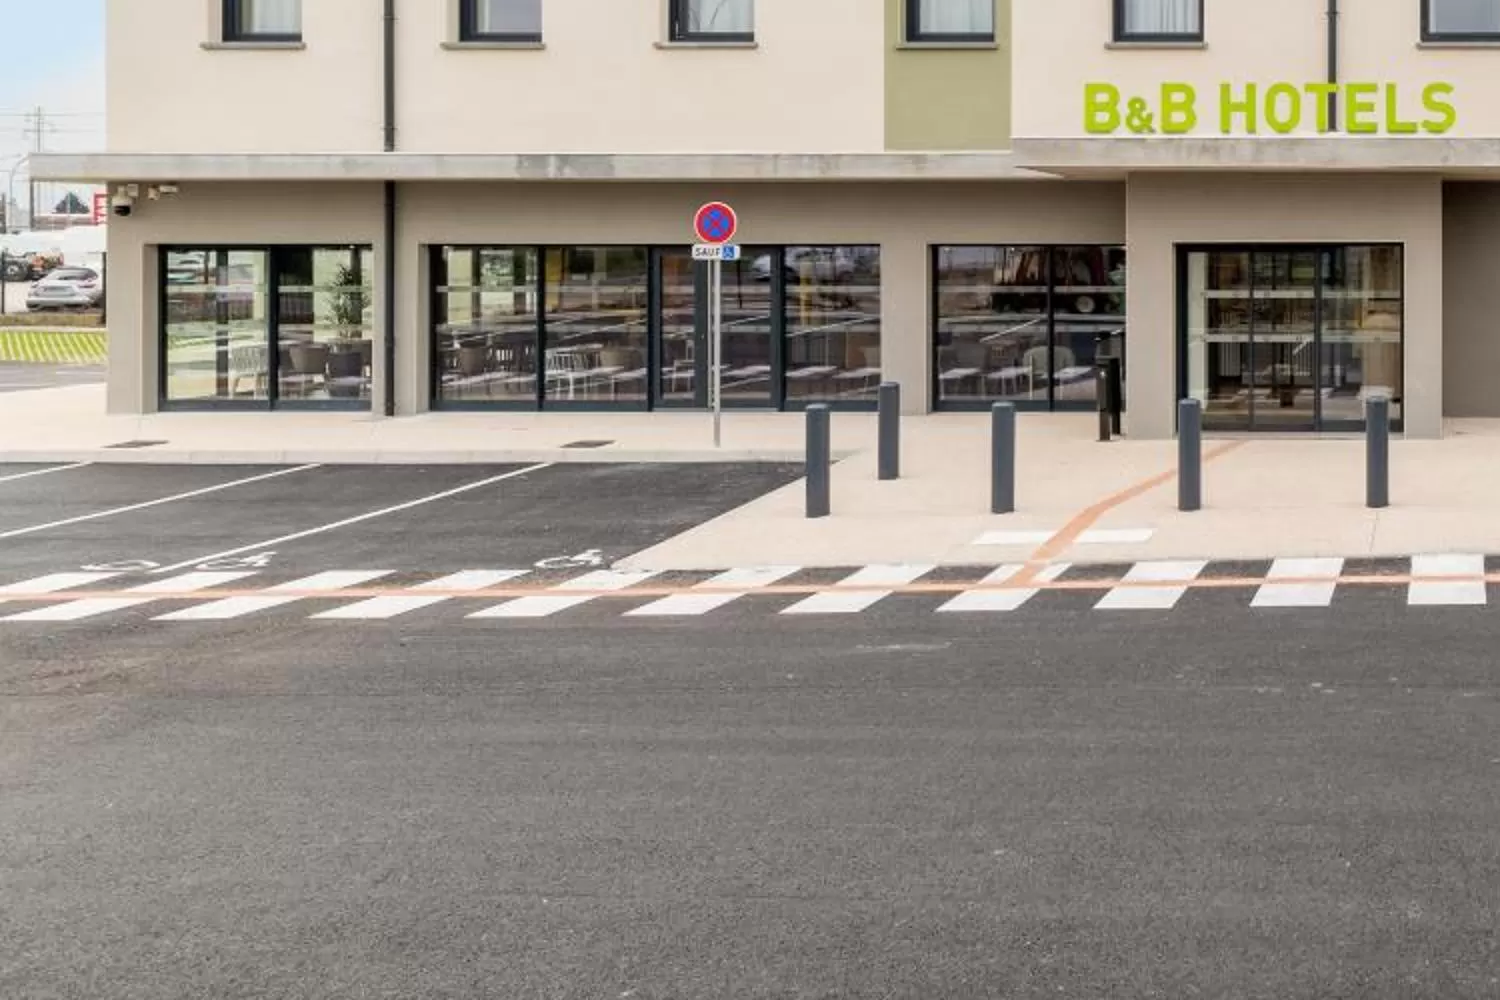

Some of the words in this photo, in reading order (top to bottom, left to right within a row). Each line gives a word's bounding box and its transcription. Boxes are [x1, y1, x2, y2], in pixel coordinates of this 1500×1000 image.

[1084, 82, 1197, 133] B&B
[1219, 82, 1456, 133] HOTELS
[695, 247, 721, 257] SAUF
